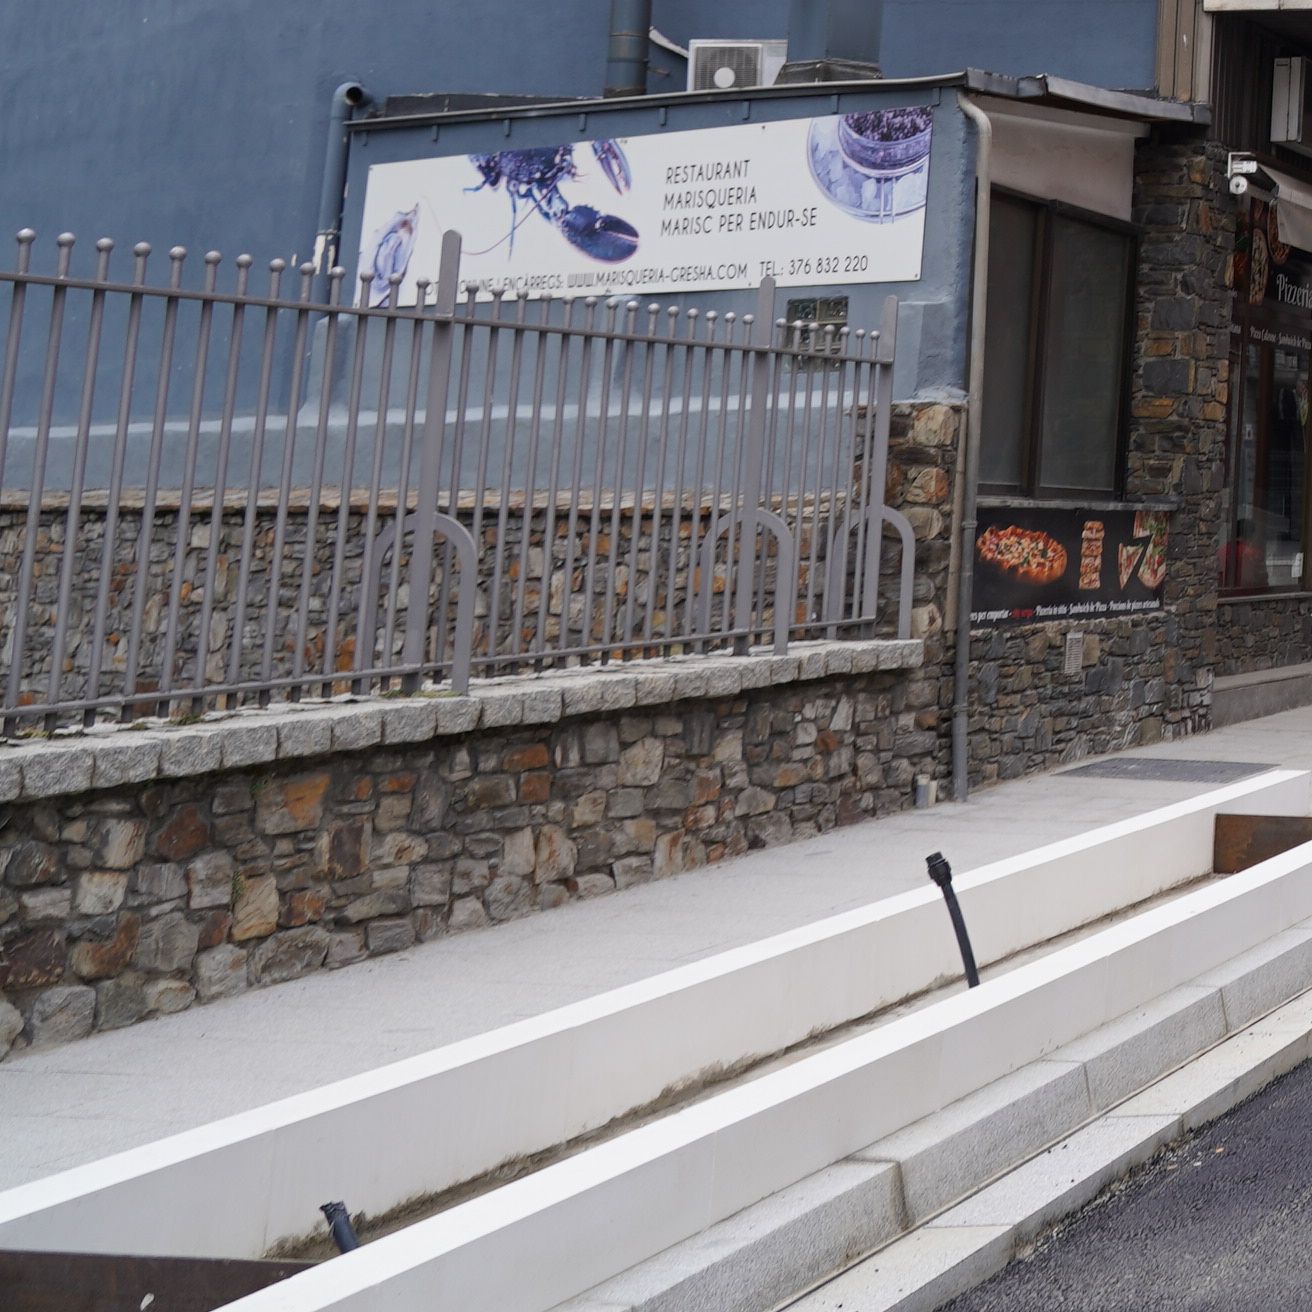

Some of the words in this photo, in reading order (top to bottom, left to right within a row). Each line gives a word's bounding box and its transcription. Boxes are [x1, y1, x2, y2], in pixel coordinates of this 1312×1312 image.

[665, 159, 750, 184] RESTAURANT
[662, 186, 757, 210] MARISQUERIA
[660, 216, 713, 236] MARISC
[718, 213, 744, 233] PER
[749, 207, 818, 231] ENDUR-SE
[788, 258, 811, 276] 376
[816, 256, 840, 274] 832
[844, 254, 868, 273] 220
[1276, 274, 1312, 309] Pizzeria
